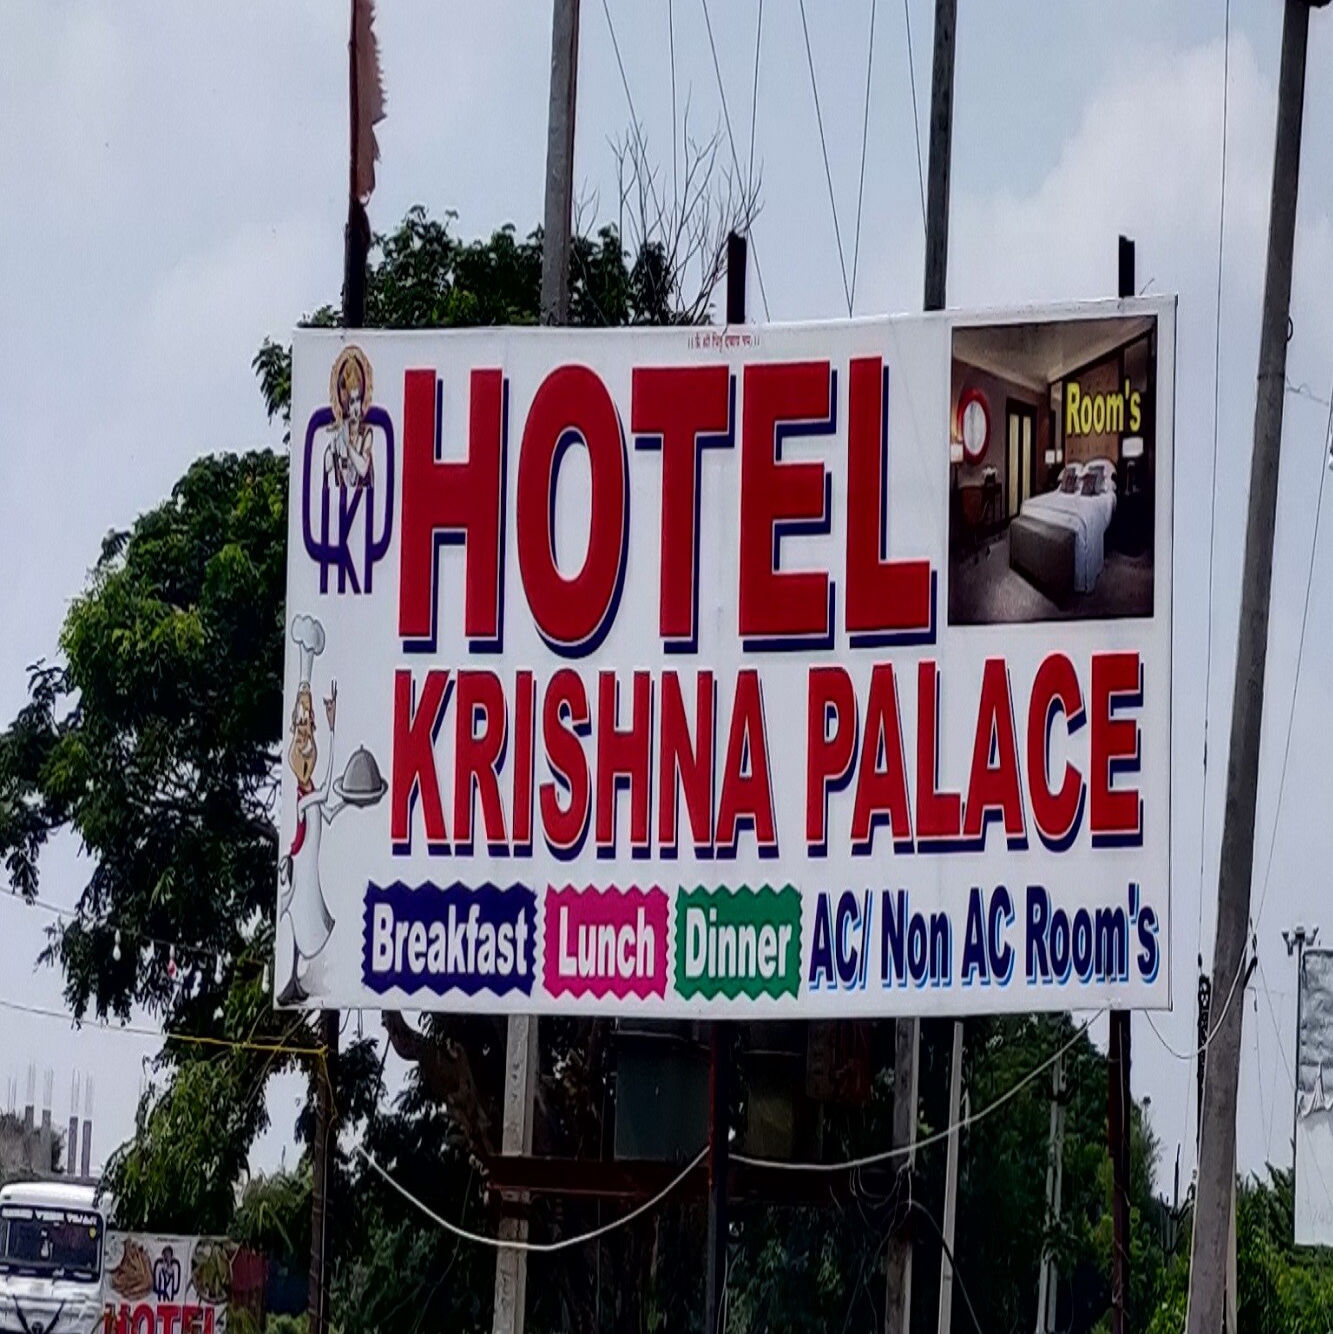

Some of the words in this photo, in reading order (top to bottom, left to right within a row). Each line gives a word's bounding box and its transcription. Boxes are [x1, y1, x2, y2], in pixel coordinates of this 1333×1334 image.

[1066, 378, 1141, 435] Room's
[398, 356, 937, 654] HOTEL
[391, 667, 780, 861] KRISHNA
[806, 651, 1144, 858] PALACE
[372, 903, 529, 976] Breakfast
[557, 906, 656, 979] Lunch
[685, 907, 793, 980] Dinner
[808, 888, 873, 991] AC/
[880, 887, 953, 989] Non
[960, 884, 1016, 987] AC
[1024, 881, 1161, 985] Room's
